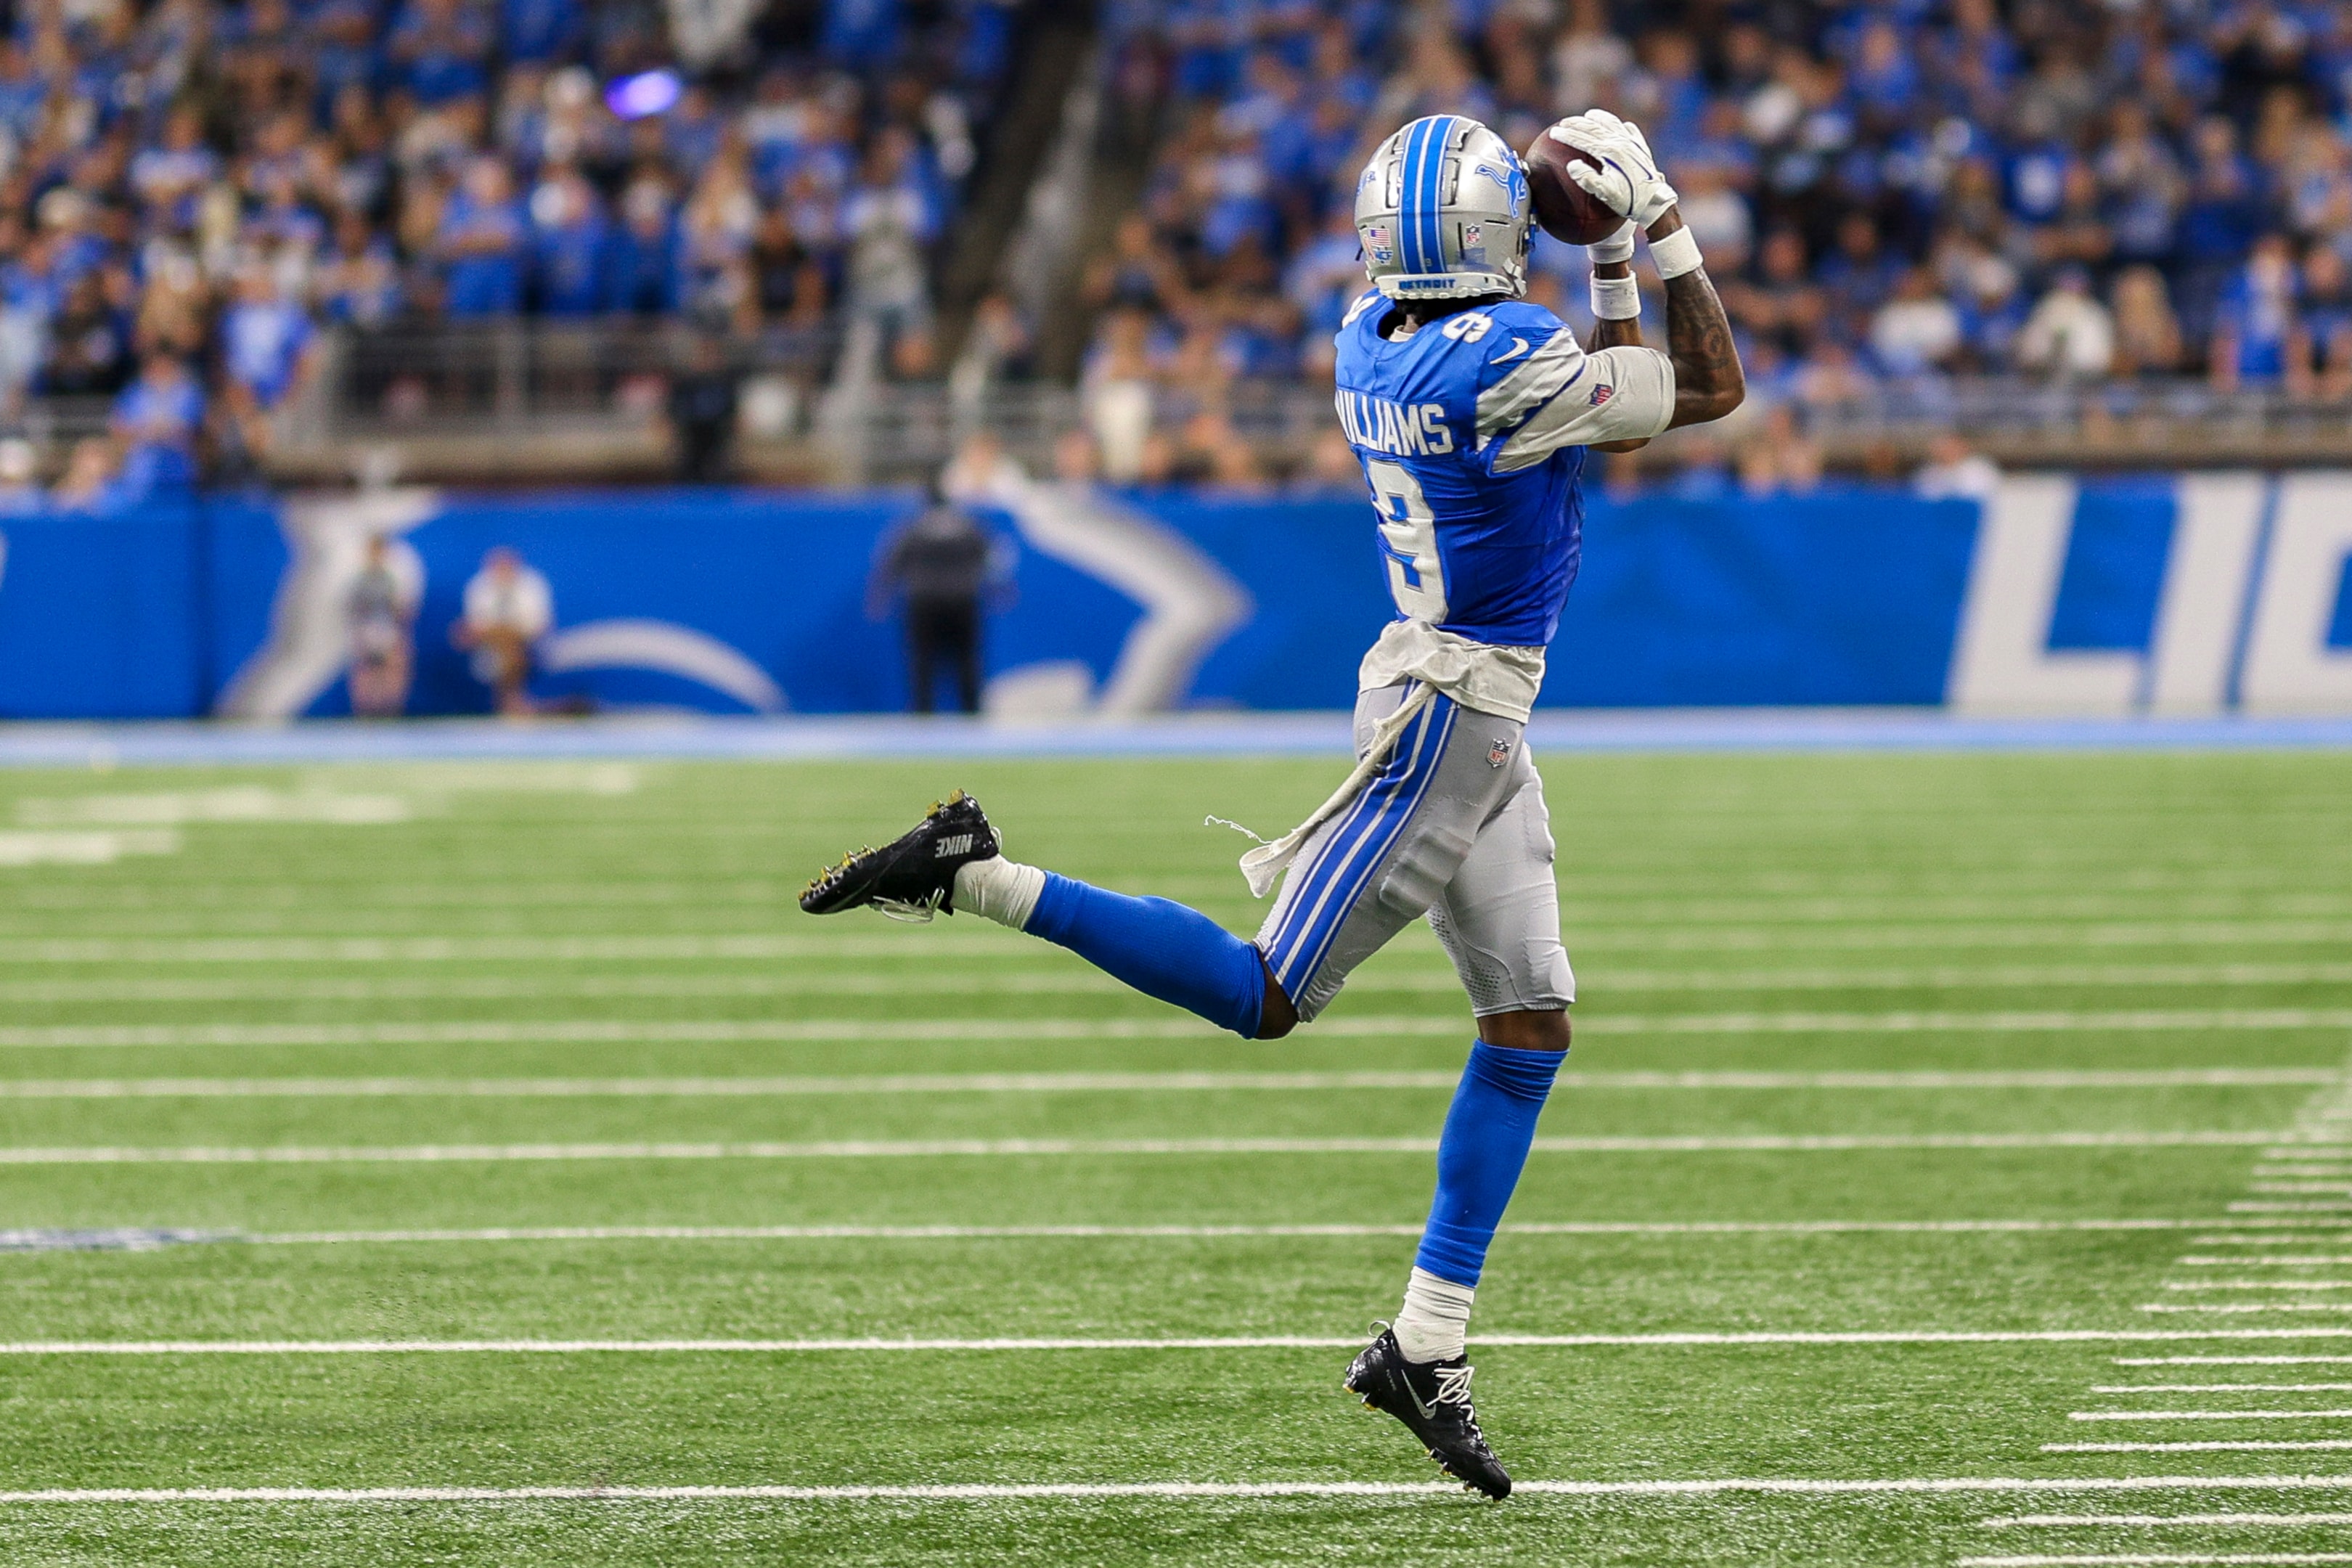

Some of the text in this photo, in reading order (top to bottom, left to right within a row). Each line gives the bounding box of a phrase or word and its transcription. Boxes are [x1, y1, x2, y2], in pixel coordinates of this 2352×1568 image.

[1399, 279, 1455, 290] DETROIT
[1442, 312, 1493, 343] 9
[1368, 458, 1449, 625] 9
[935, 833, 973, 858] NIKE
